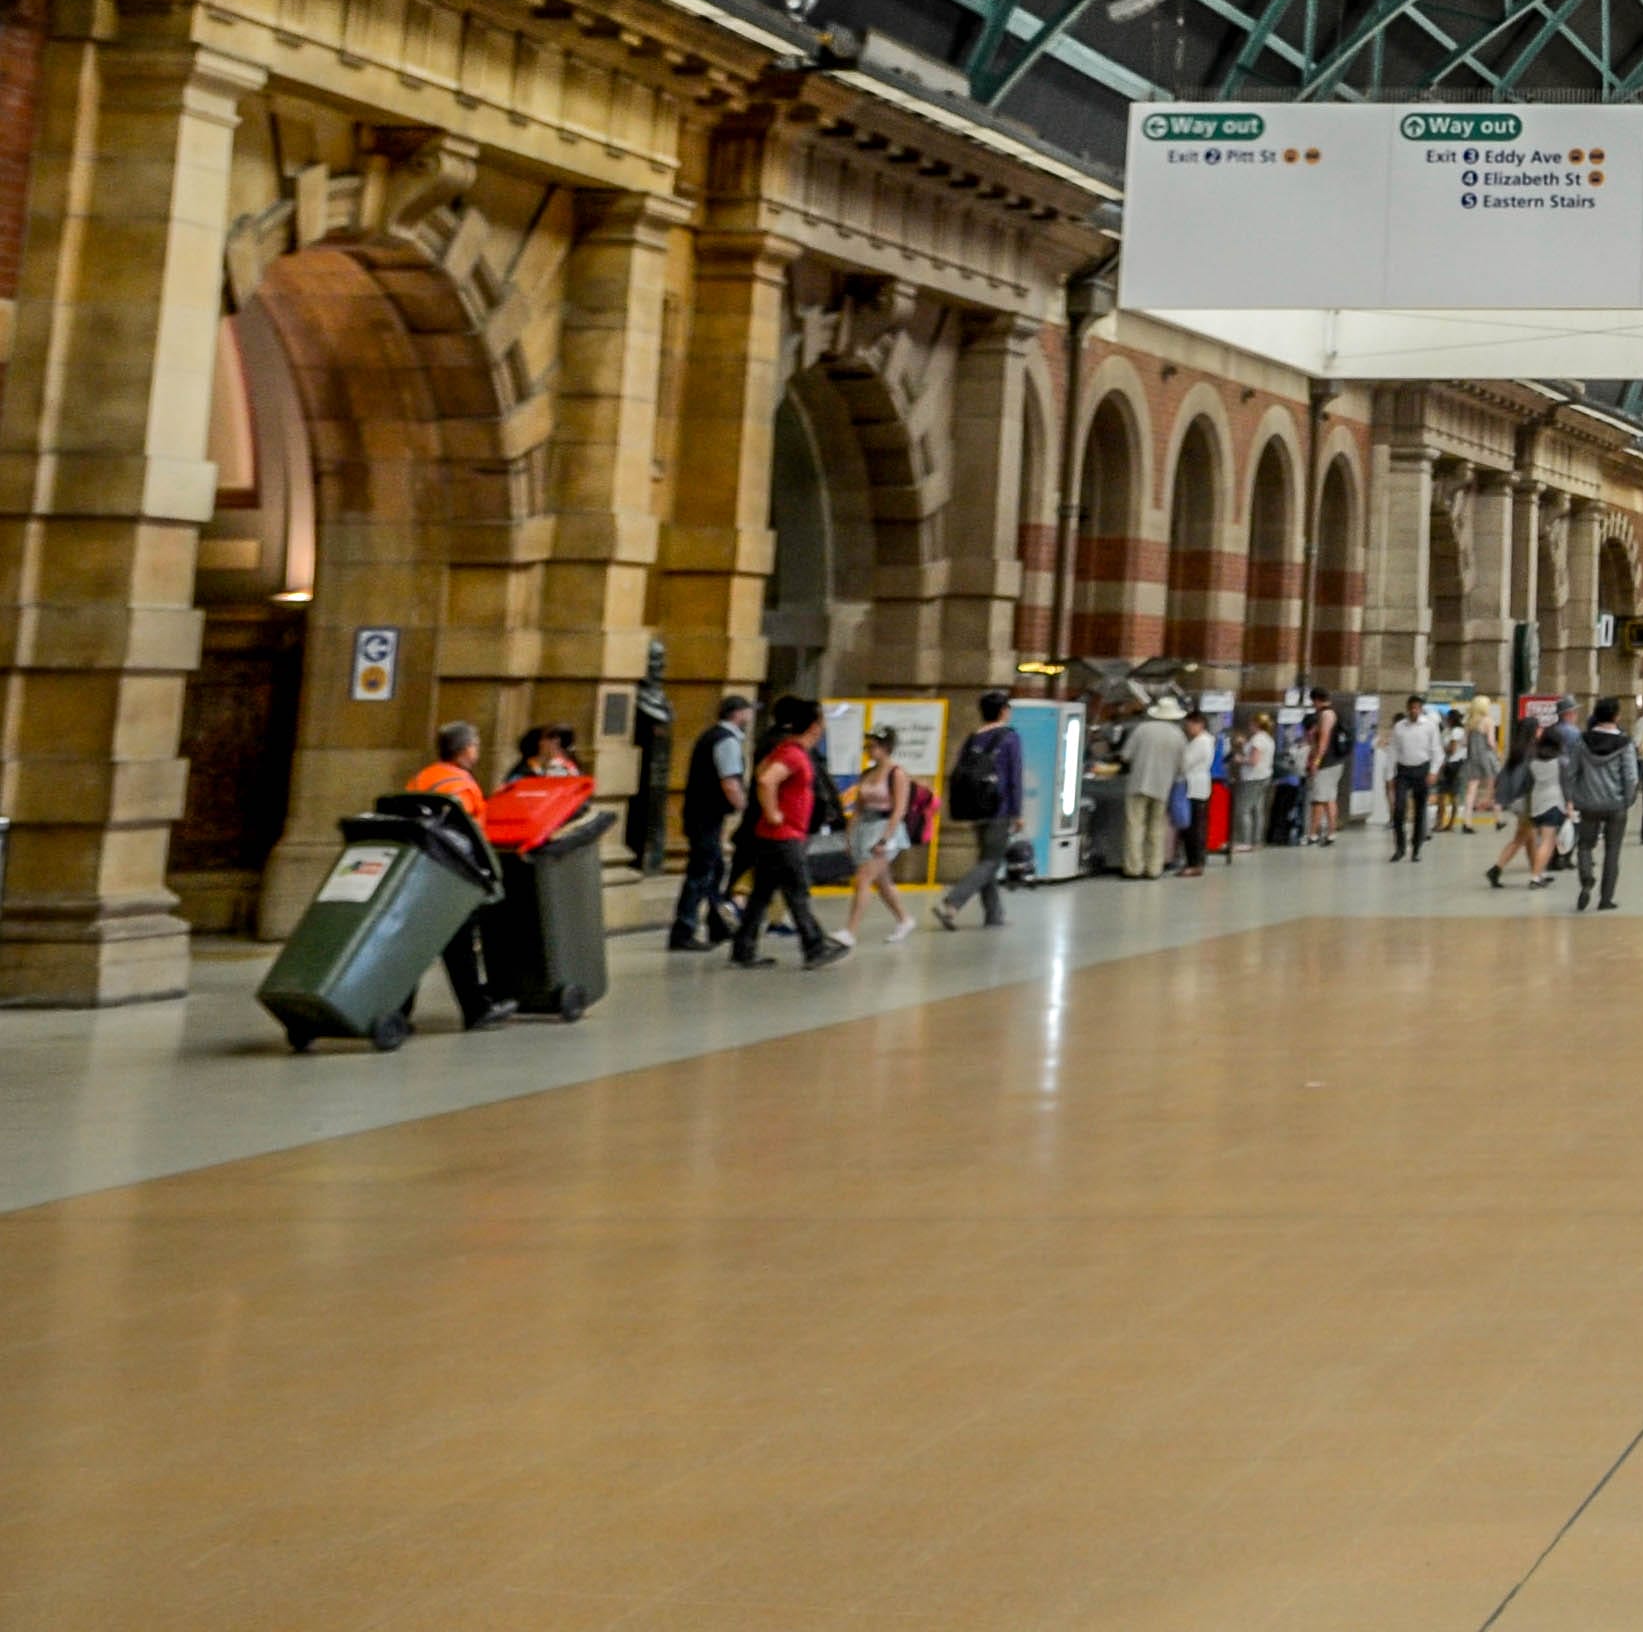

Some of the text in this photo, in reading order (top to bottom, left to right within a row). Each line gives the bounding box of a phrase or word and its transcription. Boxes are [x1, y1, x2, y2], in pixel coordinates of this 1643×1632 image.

[1170, 117, 1260, 137] Way out
[1429, 117, 1516, 137] Way out
[1167, 149, 1199, 163] Exit
[1260, 149, 1276, 163] St
[1426, 149, 1456, 163] Exit
[1485, 150, 1525, 166] Eddy
[1531, 150, 1562, 164] Ave
[1484, 172, 1559, 186] Elizabeth
[1565, 172, 1581, 186] St
[1483, 195, 1544, 208] Eastern
[1550, 194, 1595, 208] Stairs
